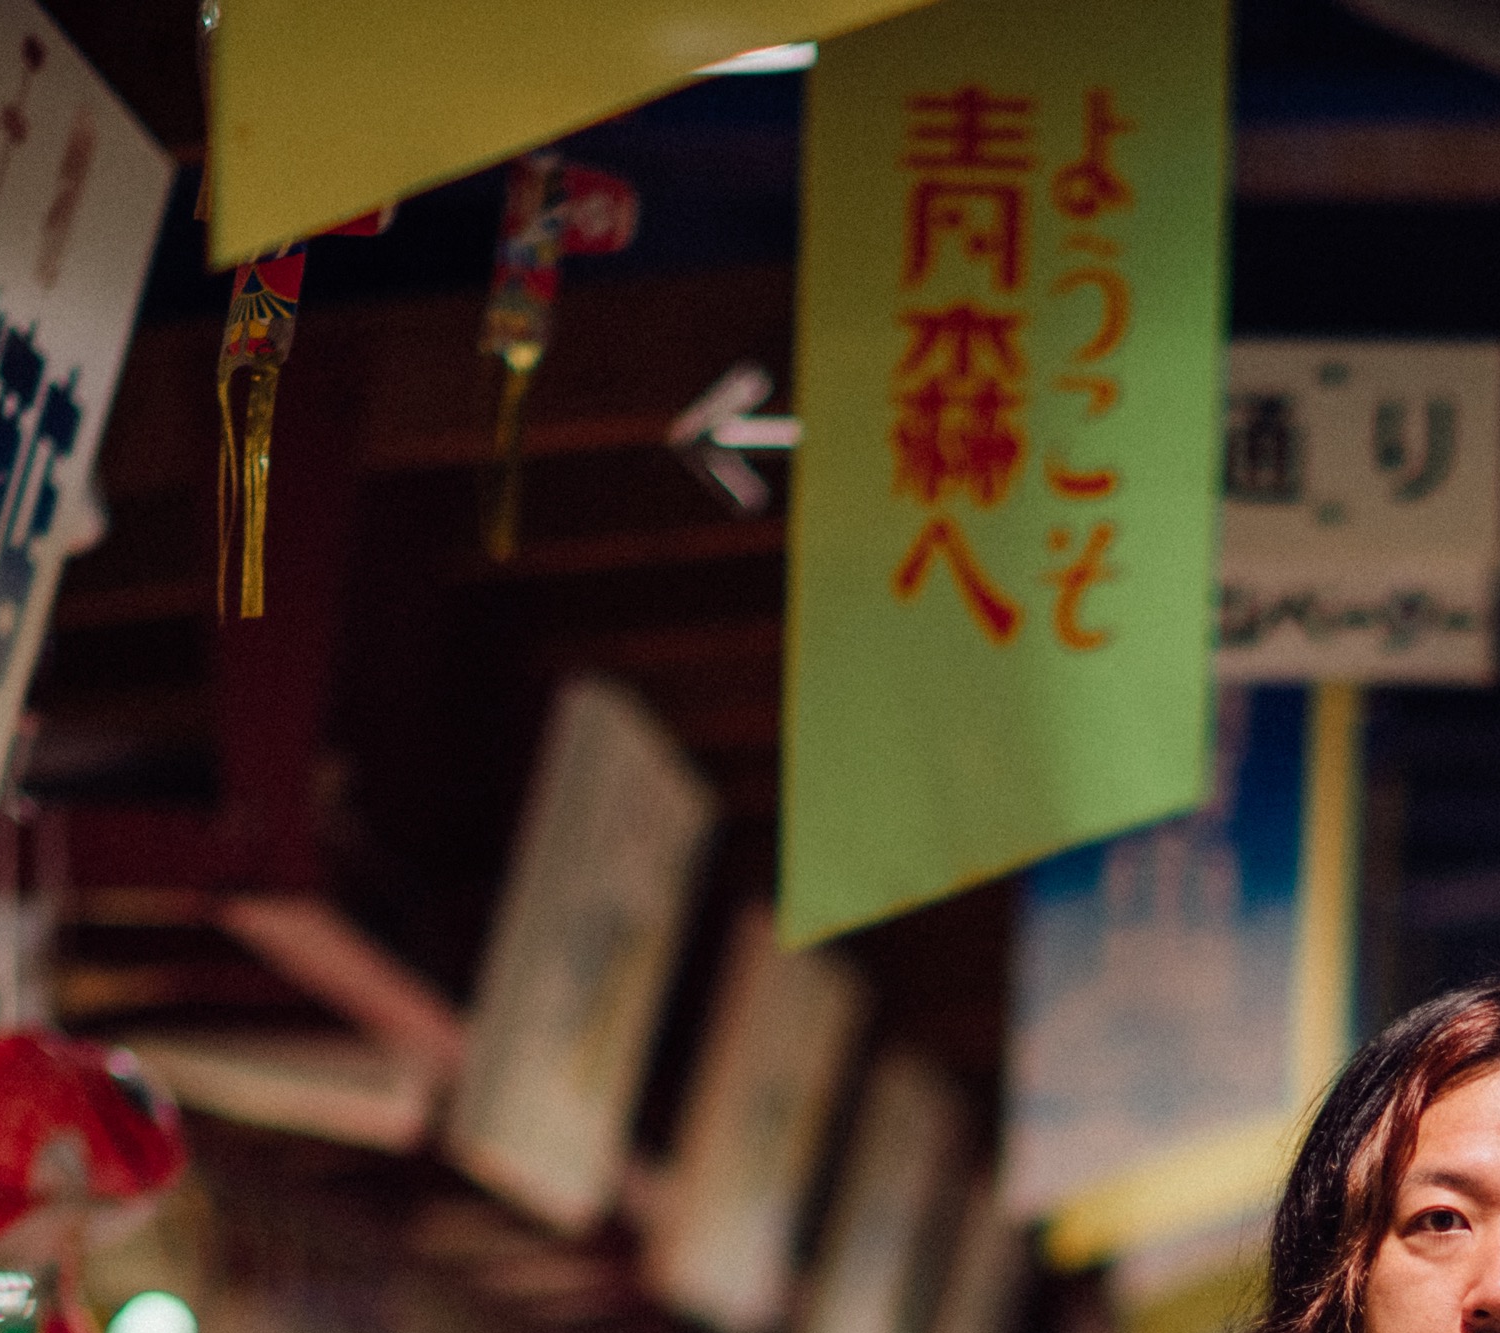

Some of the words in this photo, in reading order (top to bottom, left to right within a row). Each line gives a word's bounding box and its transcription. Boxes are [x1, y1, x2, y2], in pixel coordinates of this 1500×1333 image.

[890, 86, 1037, 648] 青森へ
[1043, 86, 1140, 652] ようこそ
